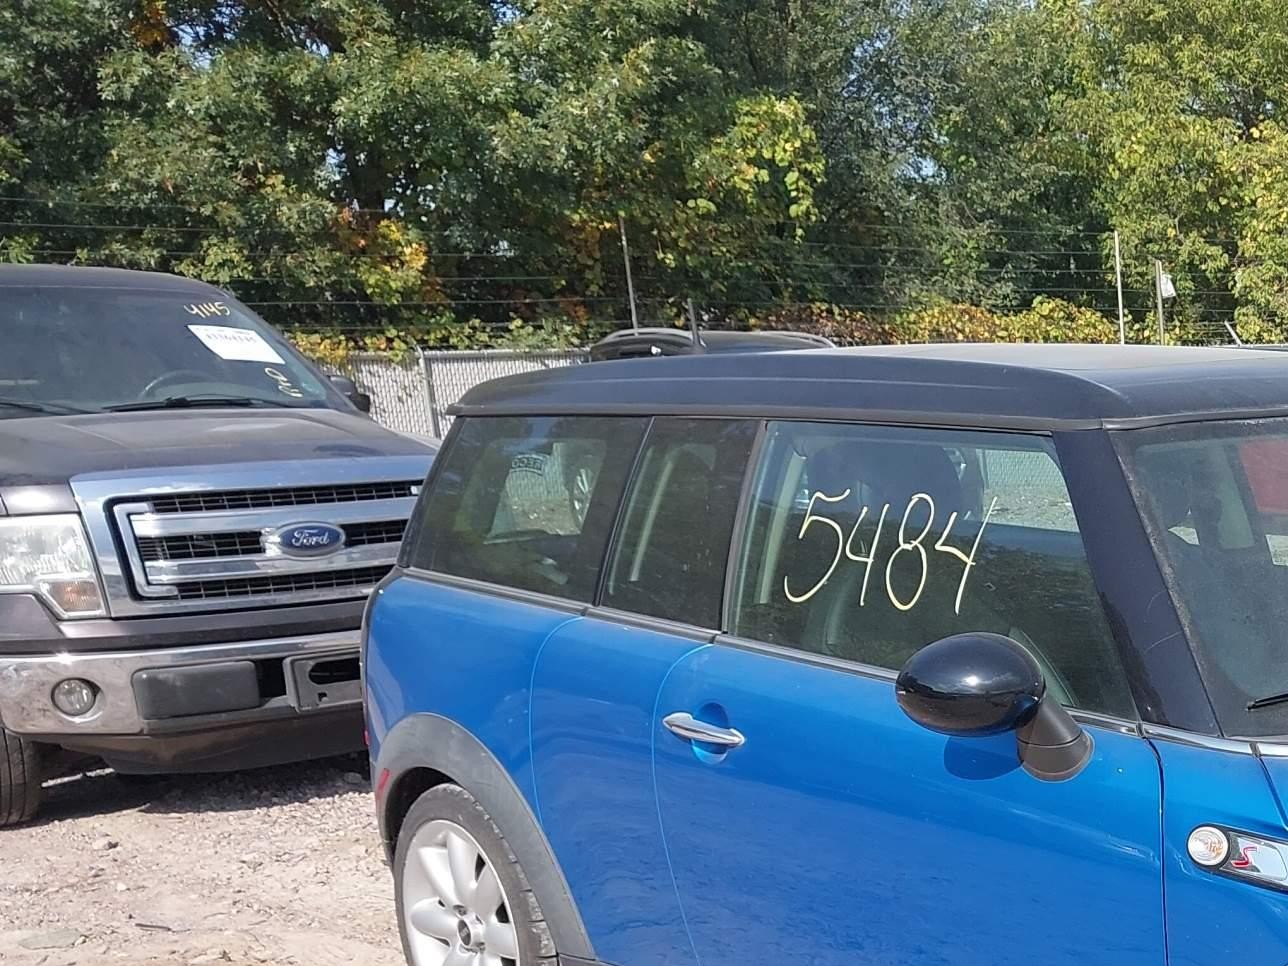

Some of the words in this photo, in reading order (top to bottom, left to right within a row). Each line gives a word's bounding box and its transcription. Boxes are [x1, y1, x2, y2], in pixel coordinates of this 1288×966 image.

[184, 302, 231, 318] 4145
[291, 529, 330, 546] Ford
[784, 488, 997, 616] 5484
